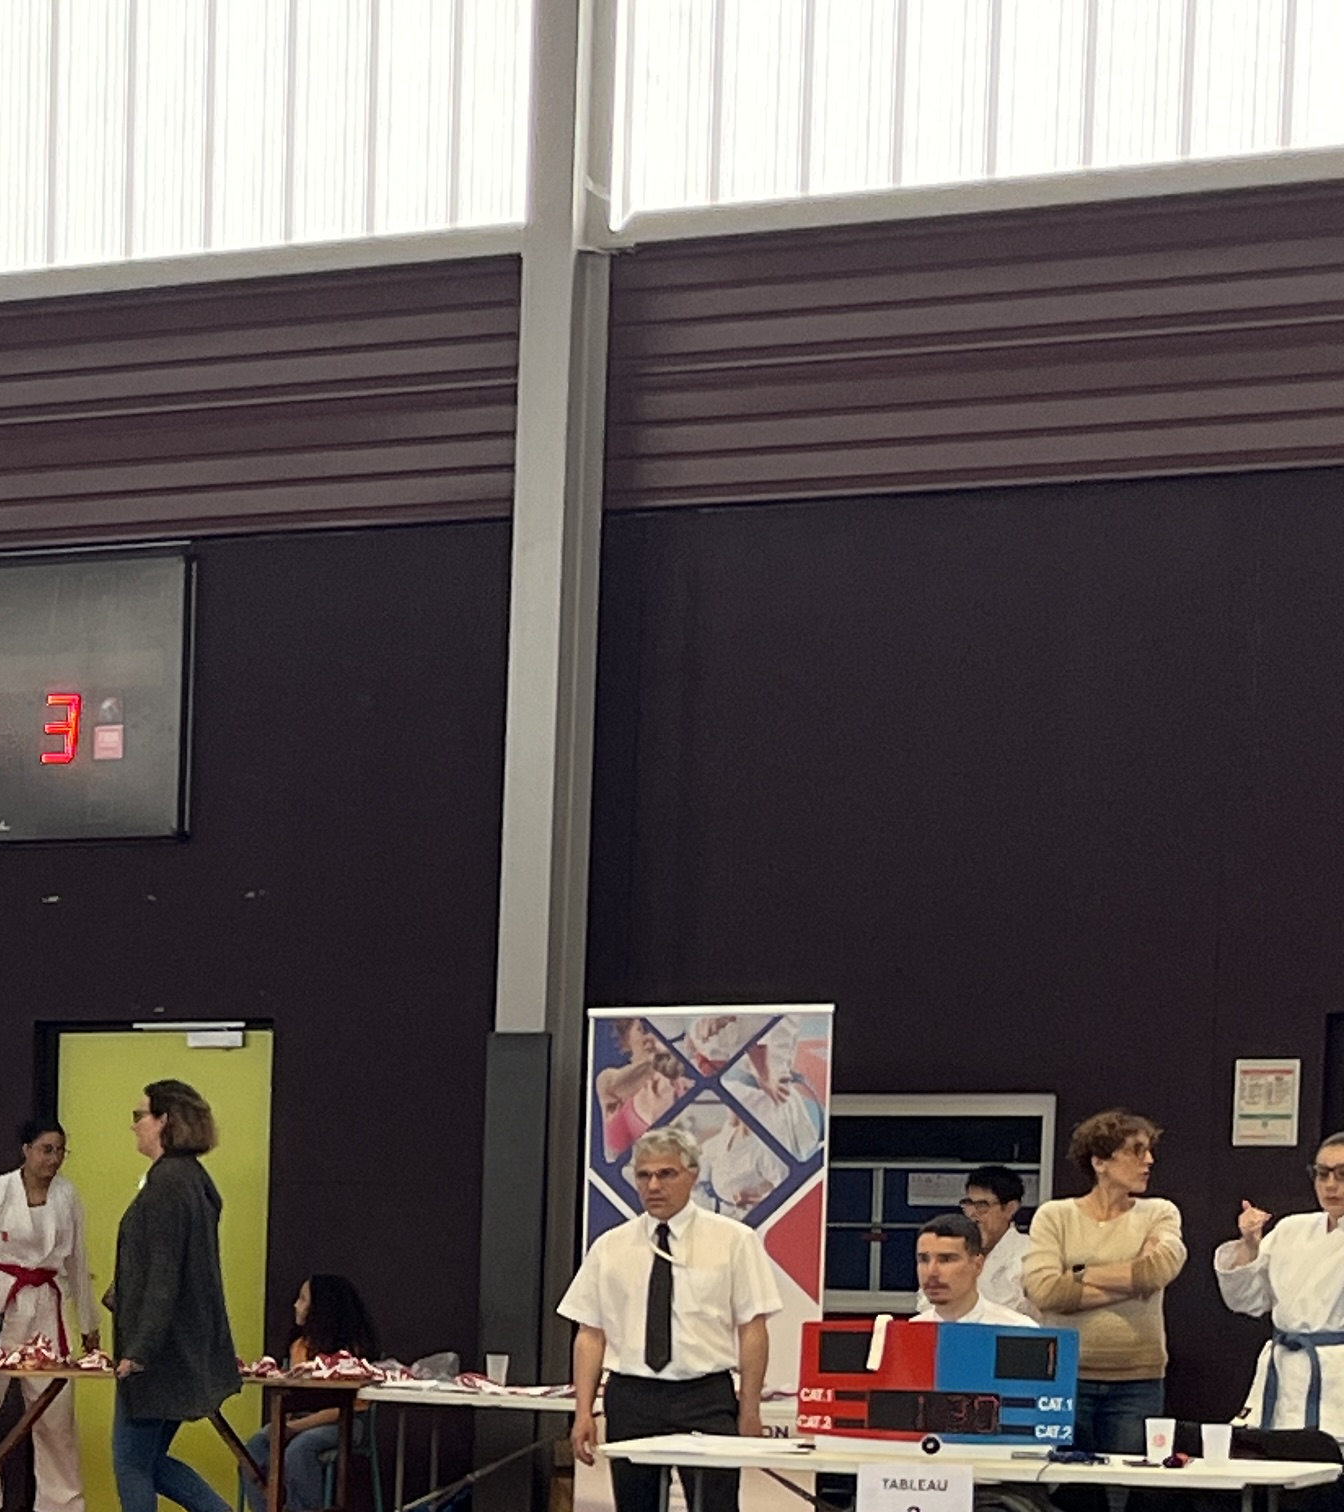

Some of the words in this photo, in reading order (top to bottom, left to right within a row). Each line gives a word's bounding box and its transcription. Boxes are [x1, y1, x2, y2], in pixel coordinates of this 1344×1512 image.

[39, 693, 82, 764] 3
[1038, 1396, 1073, 1411] CAT.1
[1035, 1424, 1073, 1440] CAT.2
[881, 1478, 948, 1491] TABLEAU
